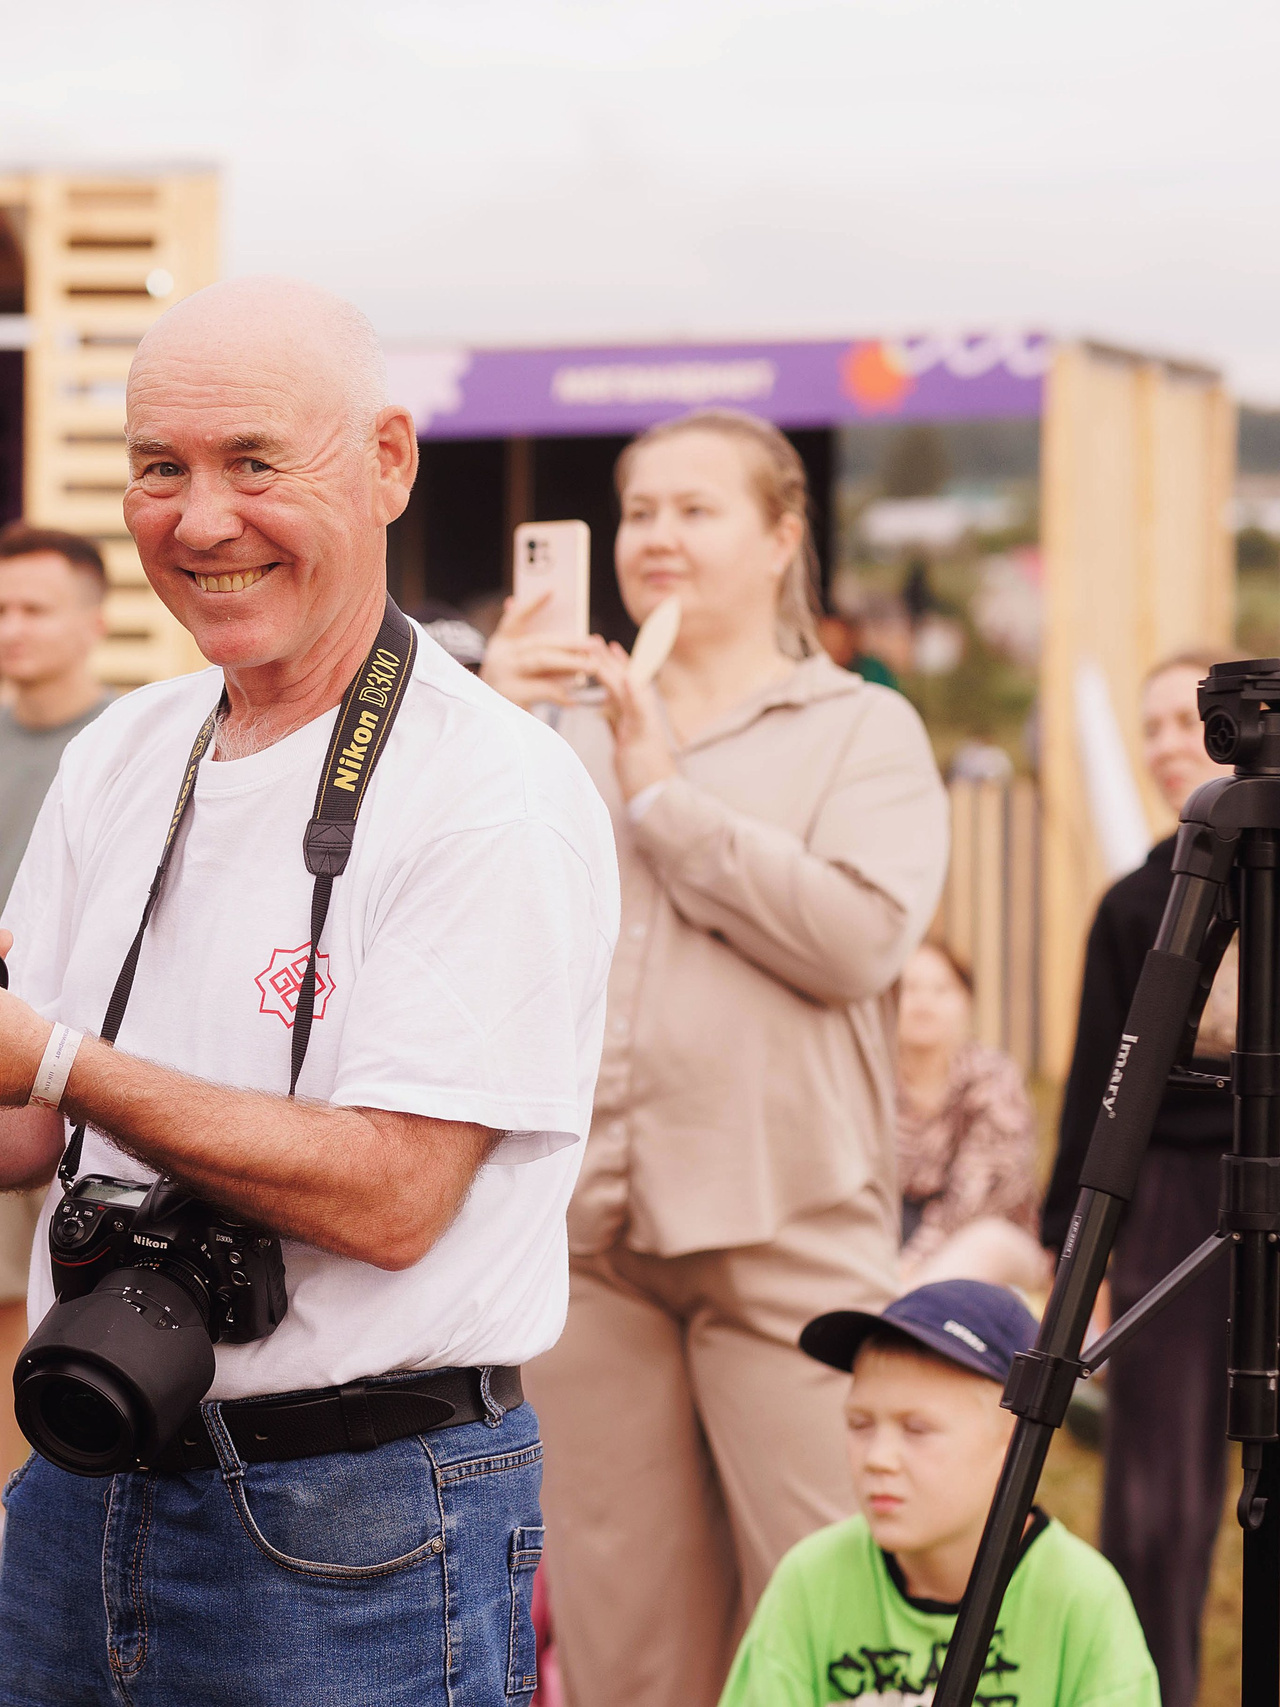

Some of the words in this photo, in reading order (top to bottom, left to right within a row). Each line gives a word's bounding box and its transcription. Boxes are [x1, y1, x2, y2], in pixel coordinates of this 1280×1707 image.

[332, 709, 380, 793] Nikon
[358, 648, 401, 709] D300
[166, 763, 197, 846] Nikon
[1102, 1032, 1139, 1113] Imary
[133, 1233, 168, 1249] Nikon
